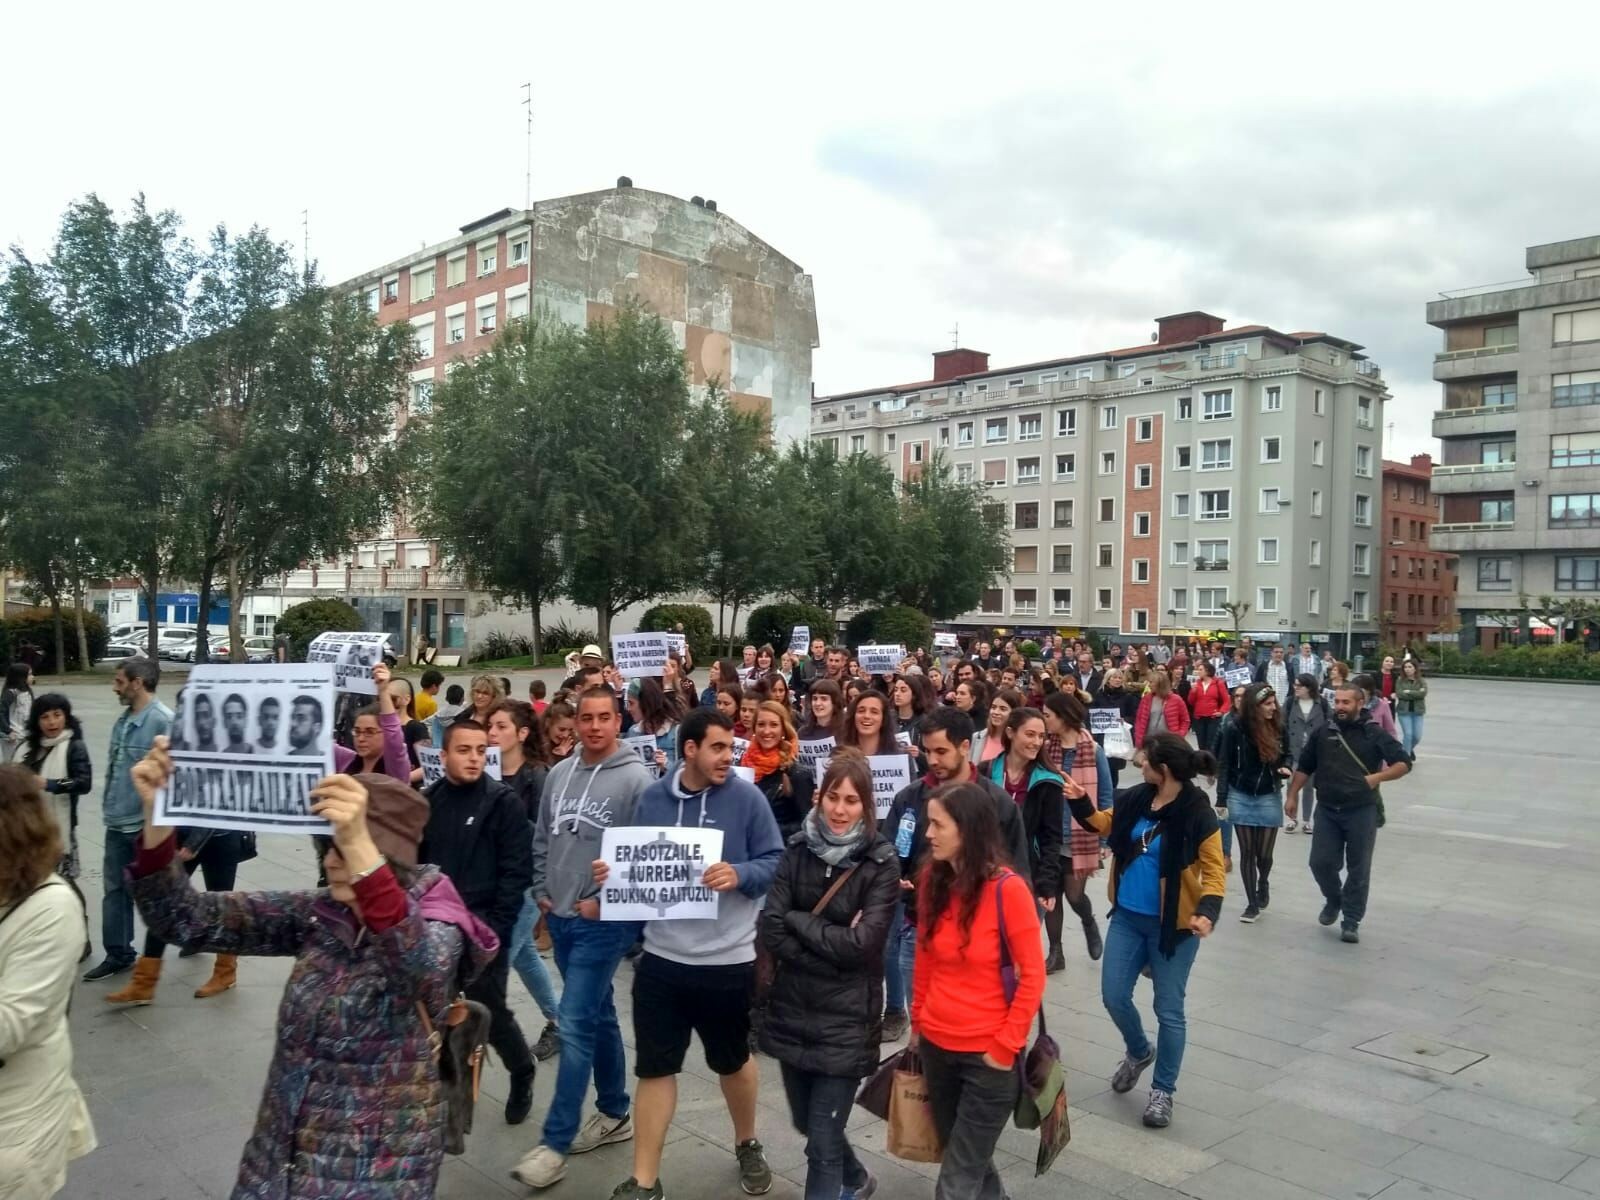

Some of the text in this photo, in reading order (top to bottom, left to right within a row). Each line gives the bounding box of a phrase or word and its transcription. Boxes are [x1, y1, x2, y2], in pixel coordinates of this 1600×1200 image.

[627, 640, 637, 649] FUE
[615, 843, 704, 864] ERASOTZAILE,
[628, 864, 690, 883] AURREAN
[606, 886, 713, 904] EDUKIKO GAITUZU!
